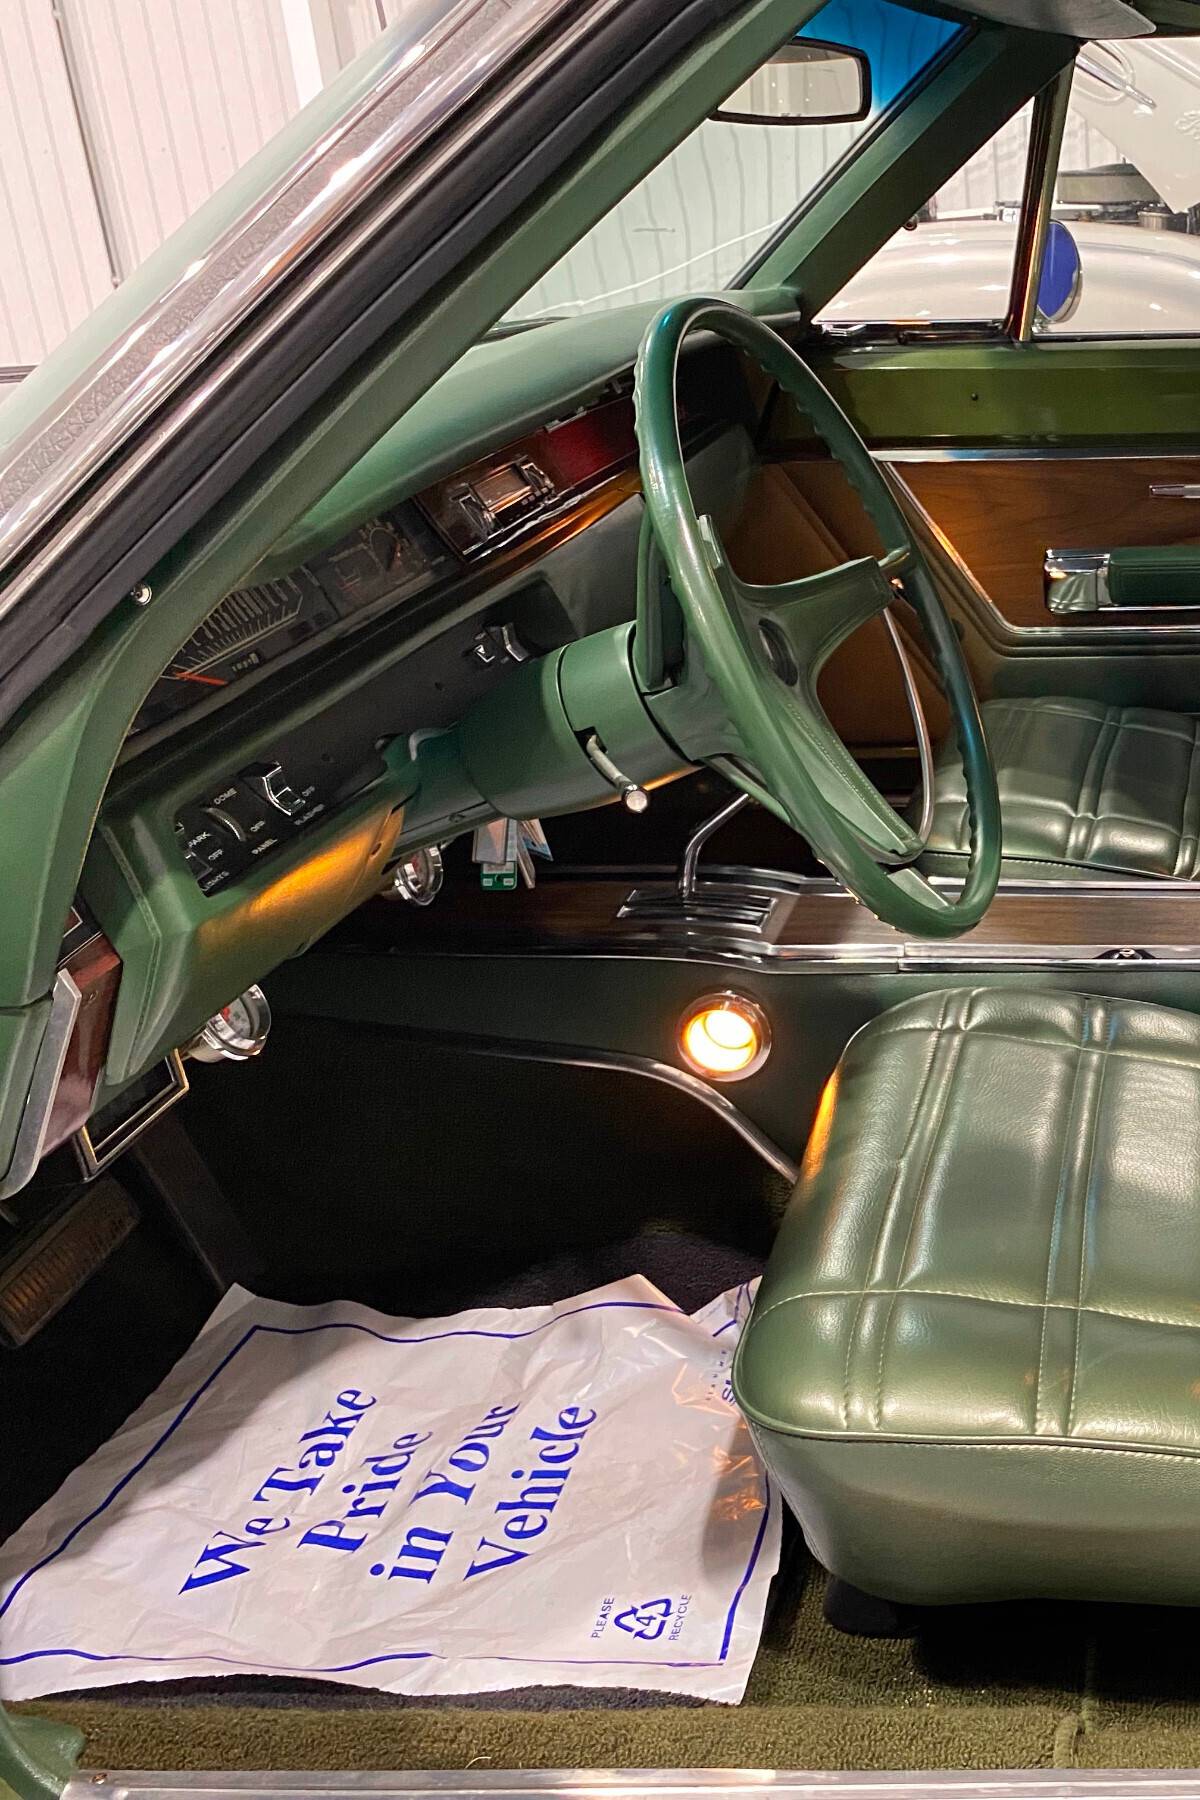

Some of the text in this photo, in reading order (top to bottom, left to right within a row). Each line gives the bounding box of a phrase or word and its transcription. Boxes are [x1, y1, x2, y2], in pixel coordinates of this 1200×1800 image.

[178, 1389, 377, 1595] We Take
[296, 1431, 433, 1553] Pride
[369, 1402, 521, 1584] in Your
[462, 1406, 597, 1581] Vehicle
[590, 1597, 615, 1639] PLEASE
[668, 1594, 692, 1641] RECYCLE
